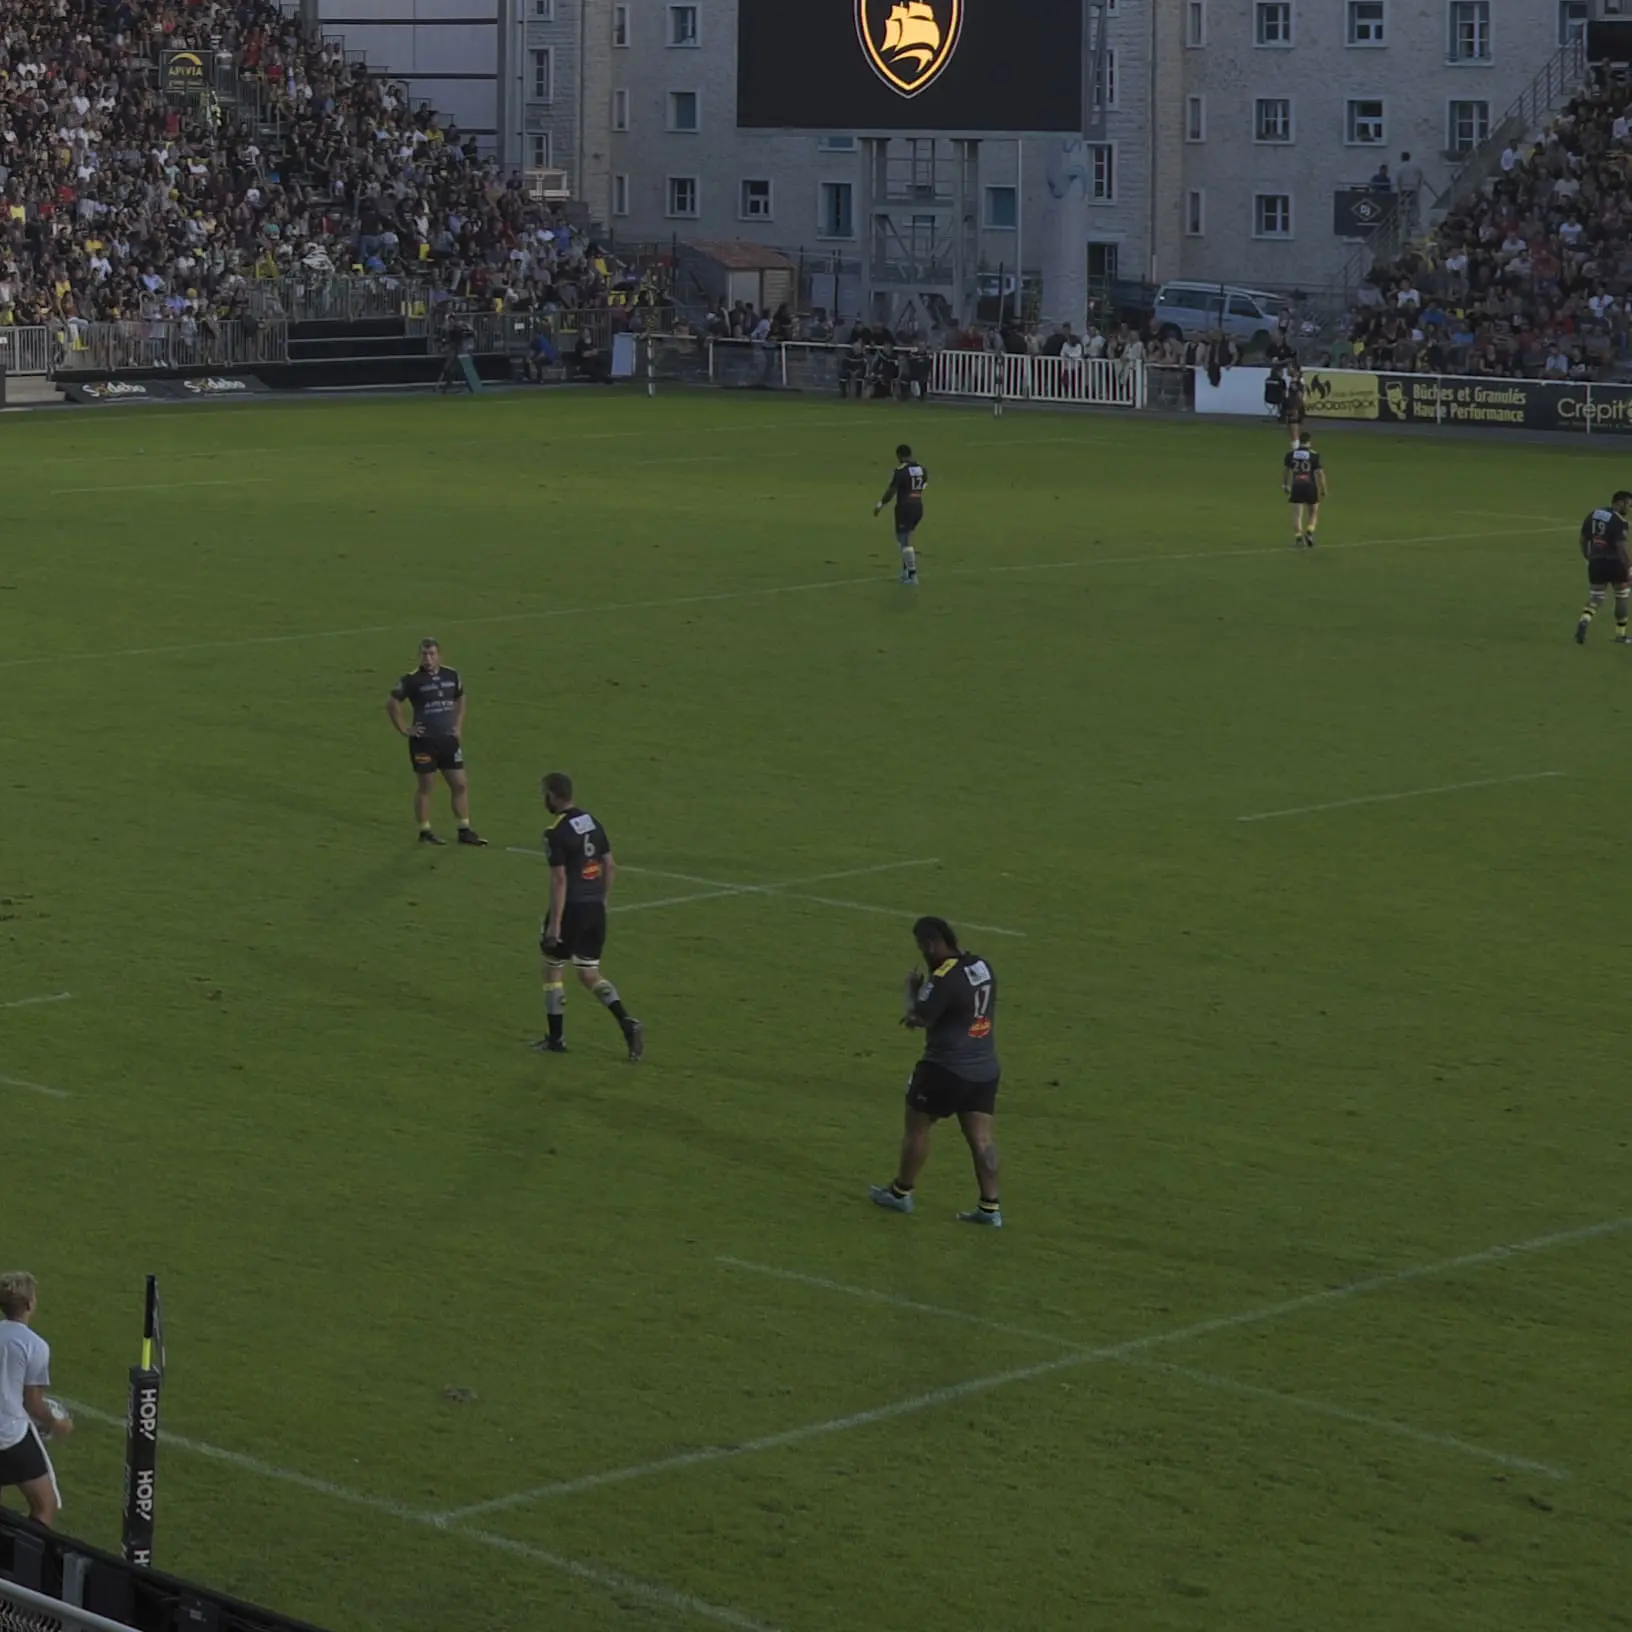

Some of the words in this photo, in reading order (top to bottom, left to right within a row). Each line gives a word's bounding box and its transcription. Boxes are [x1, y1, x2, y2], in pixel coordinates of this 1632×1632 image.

[82, 381, 146, 397] Sodebo
[183, 376, 246, 393] Sodebo
[1457, 387, 1471, 402] et
[1450, 402, 1525, 423] Performance
[1592, 519, 1605, 536] 19
[583, 833, 596, 857] 6
[974, 984, 991, 1018] 17
[140, 1388, 157, 1441] HOP!
[136, 1468, 154, 1521] HOP!
